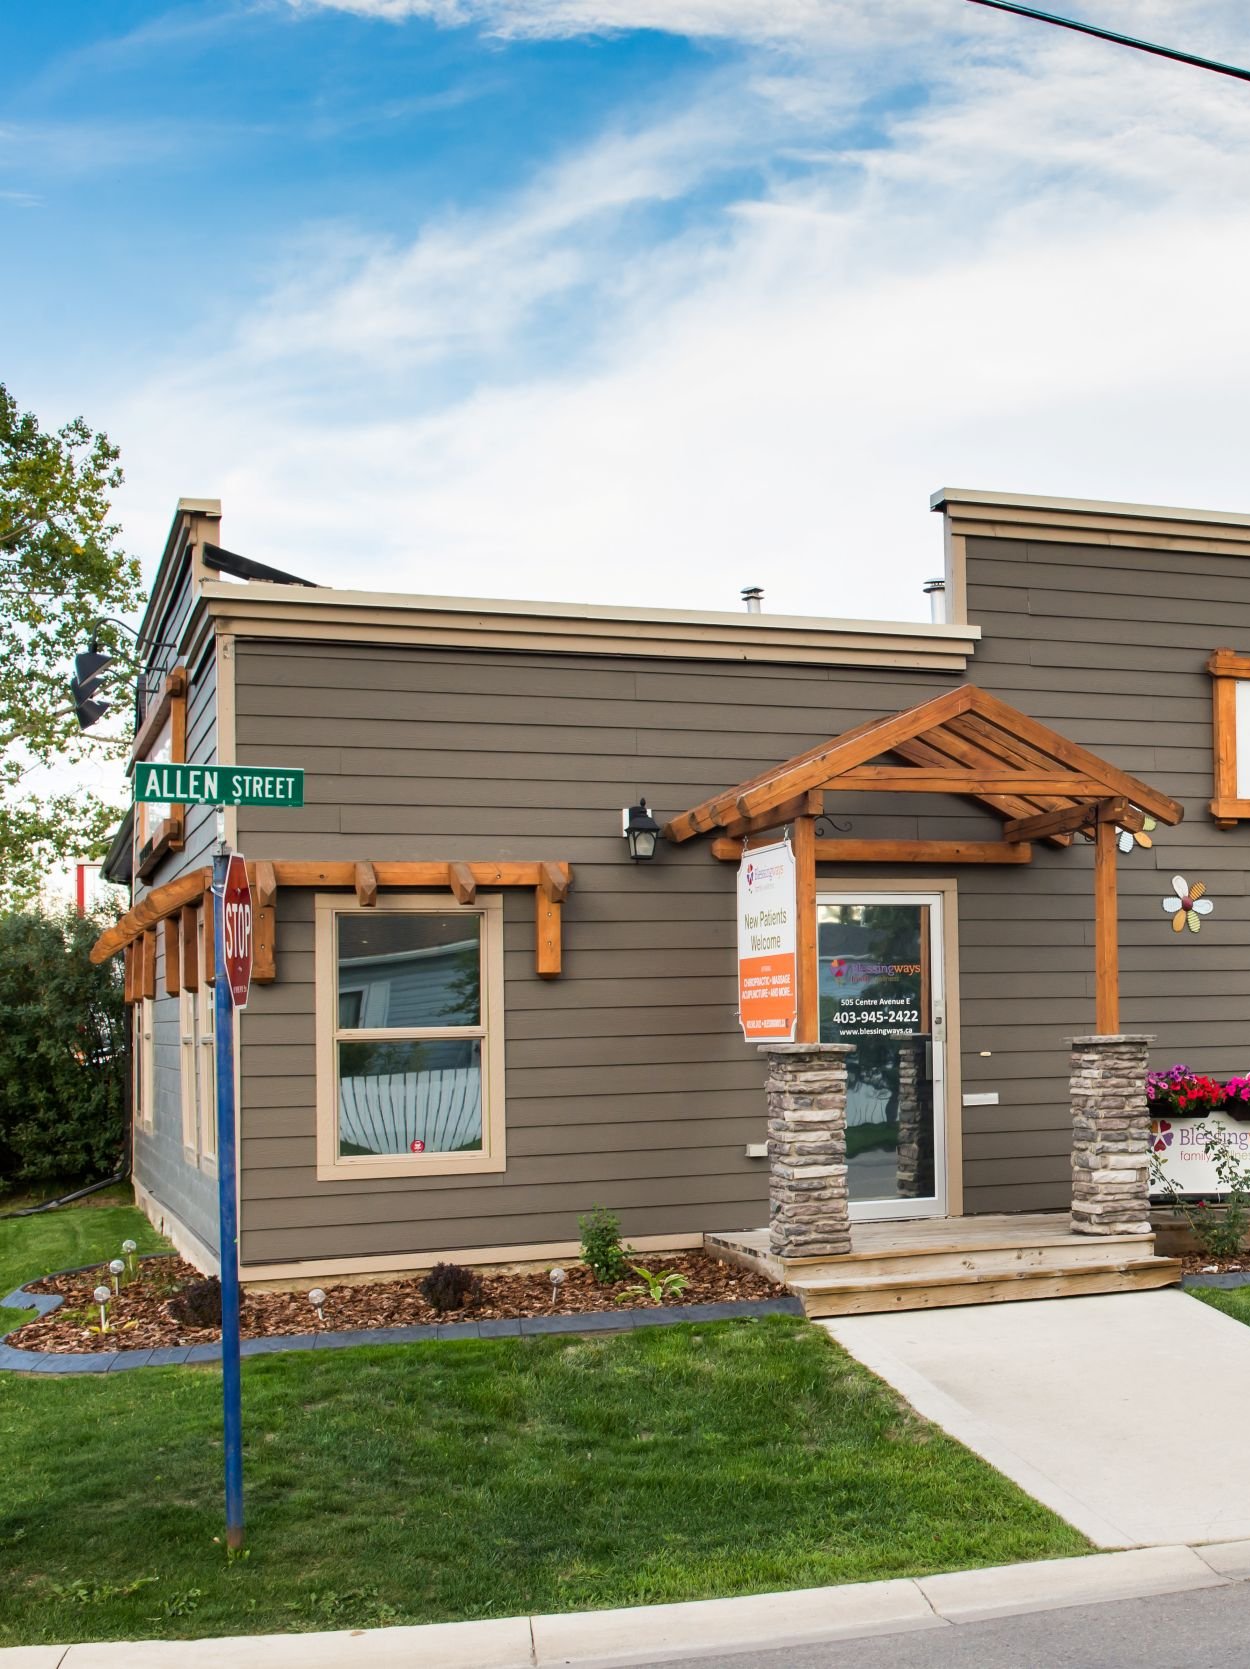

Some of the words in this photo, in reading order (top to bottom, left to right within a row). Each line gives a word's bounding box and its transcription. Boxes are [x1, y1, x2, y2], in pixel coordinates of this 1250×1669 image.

[145, 769, 218, 799] ALLEN
[231, 775, 295, 798] STREET
[744, 913, 759, 931] New
[759, 908, 787, 928] Patients
[225, 902, 250, 960] STOP
[751, 935, 781, 951] Welcome
[855, 998, 878, 1006] Centre
[833, 1010, 919, 1024] 403-945-2422
[840, 1027, 913, 1036] www.blessingways.ca
[1180, 1150, 1212, 1162] family
